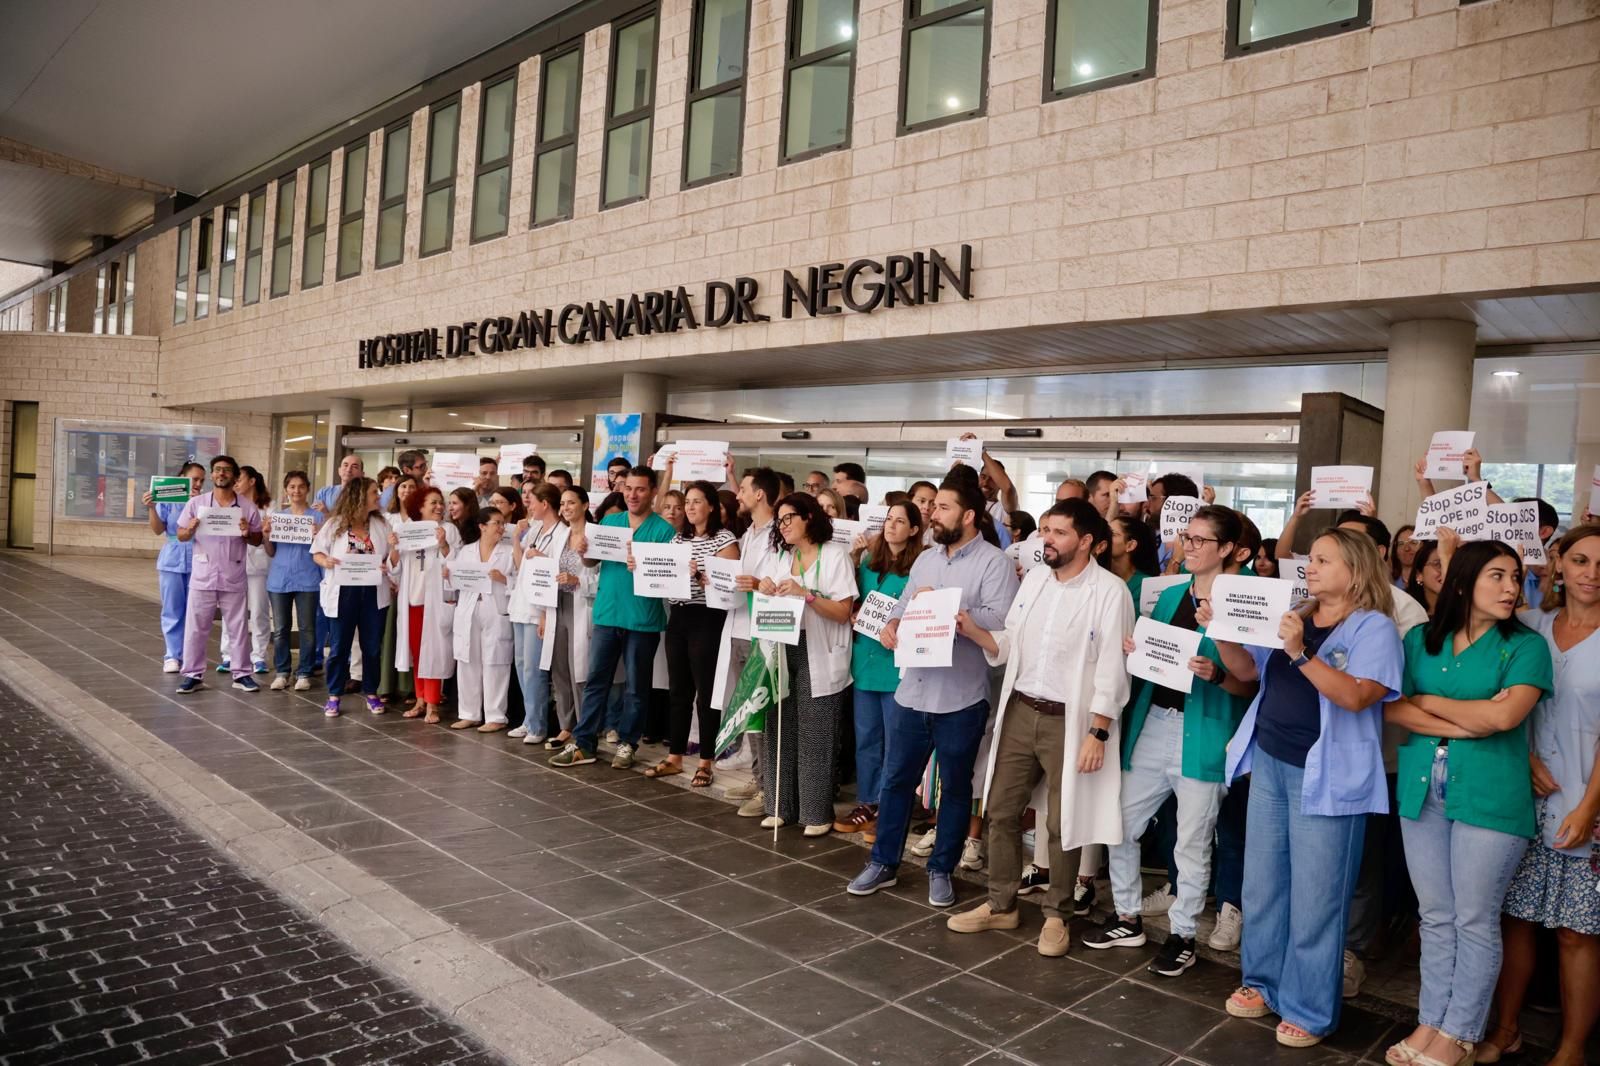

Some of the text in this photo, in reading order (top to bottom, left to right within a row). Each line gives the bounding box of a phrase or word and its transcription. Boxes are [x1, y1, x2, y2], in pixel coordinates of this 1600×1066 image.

[359, 244, 973, 369] HOSPITAL DE GRAN CANARIA DR. NEGRIN
[67, 490, 74, 499] 3
[97, 492, 104, 500] 4
[1420, 486, 1483, 514] Stop SCS
[1164, 500, 1193, 514] Stop
[272, 516, 313, 525] Stop SCS
[1425, 508, 1479, 526] la OPE no
[1486, 508, 1536, 527] Stop SCS
[291, 534, 311, 542] juego
[1163, 528, 1174, 536] es
[1491, 529, 1534, 541] la OPE no
[1523, 548, 1541, 559] uego
[867, 594, 885, 610] Stop
[1225, 598, 1268, 607] NOMBRAMIENTOS
[863, 607, 887, 622] la OPE
[857, 619, 865, 628] es
[866, 623, 876, 631] un
